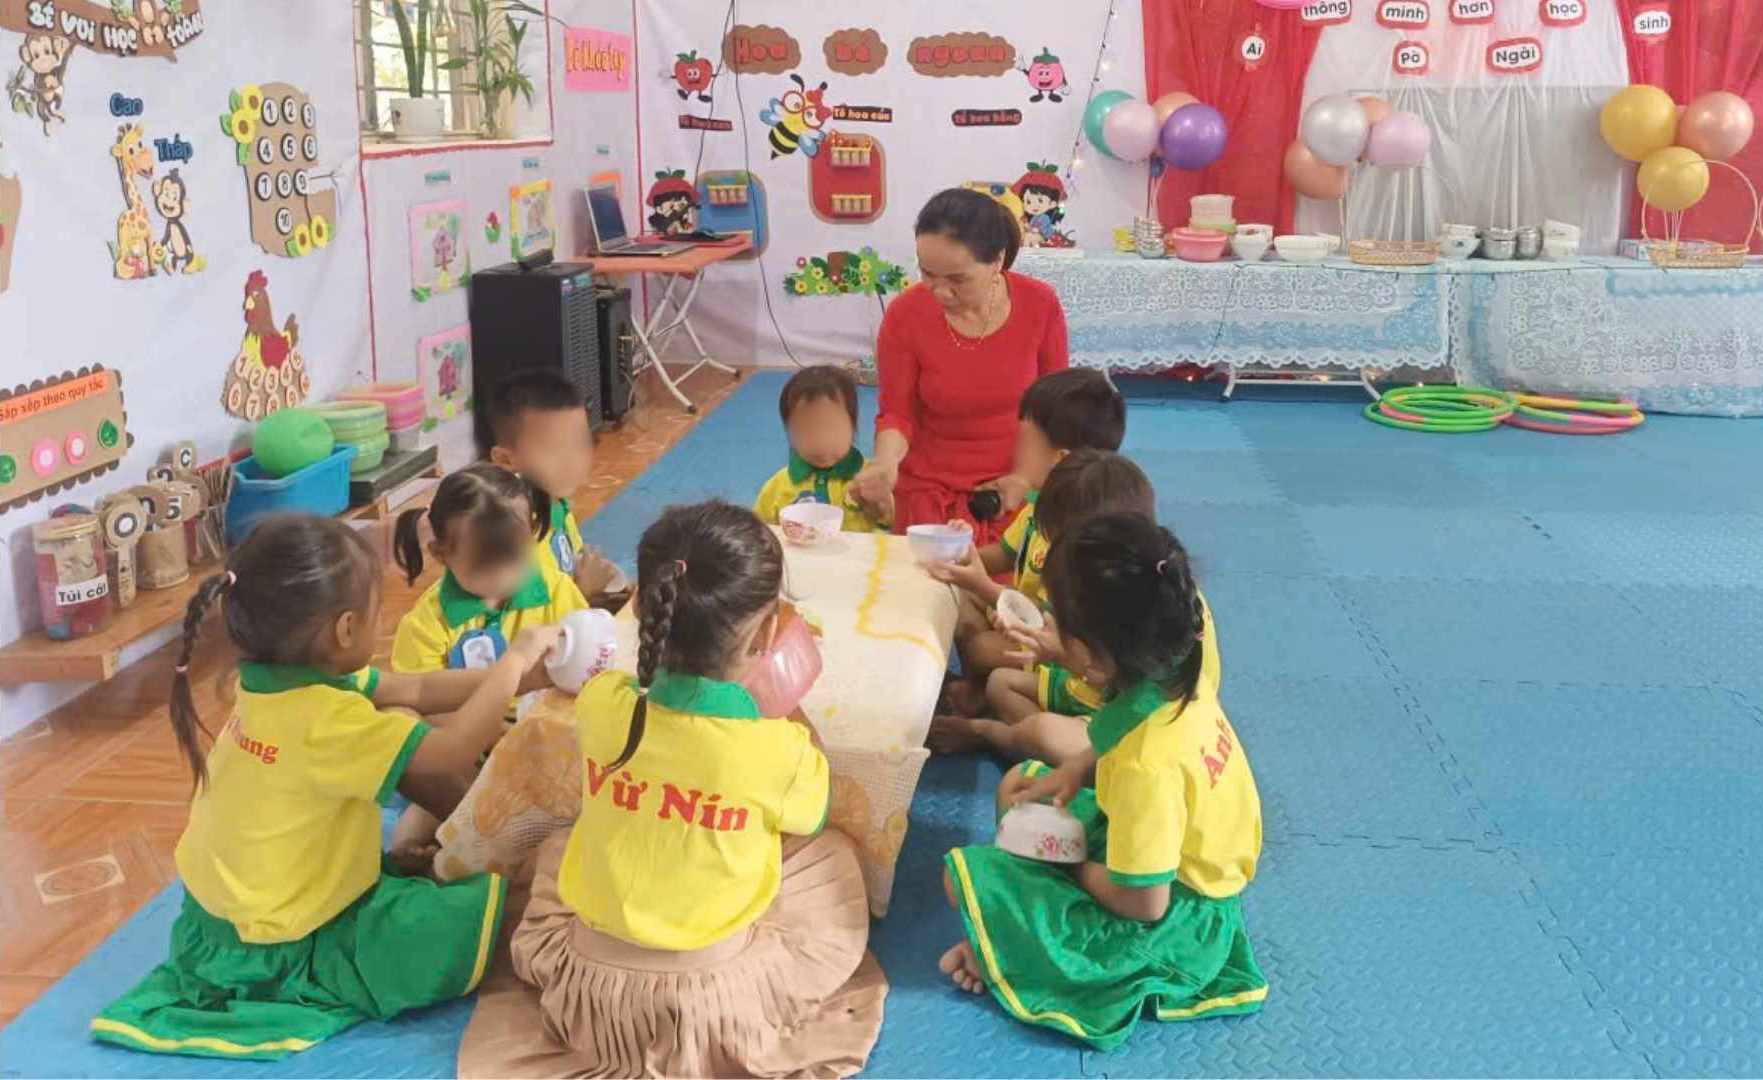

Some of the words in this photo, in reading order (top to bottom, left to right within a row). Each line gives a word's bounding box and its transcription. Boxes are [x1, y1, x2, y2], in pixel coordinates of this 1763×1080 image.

[1385, 5, 1424, 20] minh
[1549, 3, 1578, 17] học
[1639, 15, 1669, 30] sinh
[1246, 42, 1262, 55] Ai
[110, 93, 144, 117] Cao
[587, 757, 648, 812] Vừ
[658, 783, 748, 832] Nín
